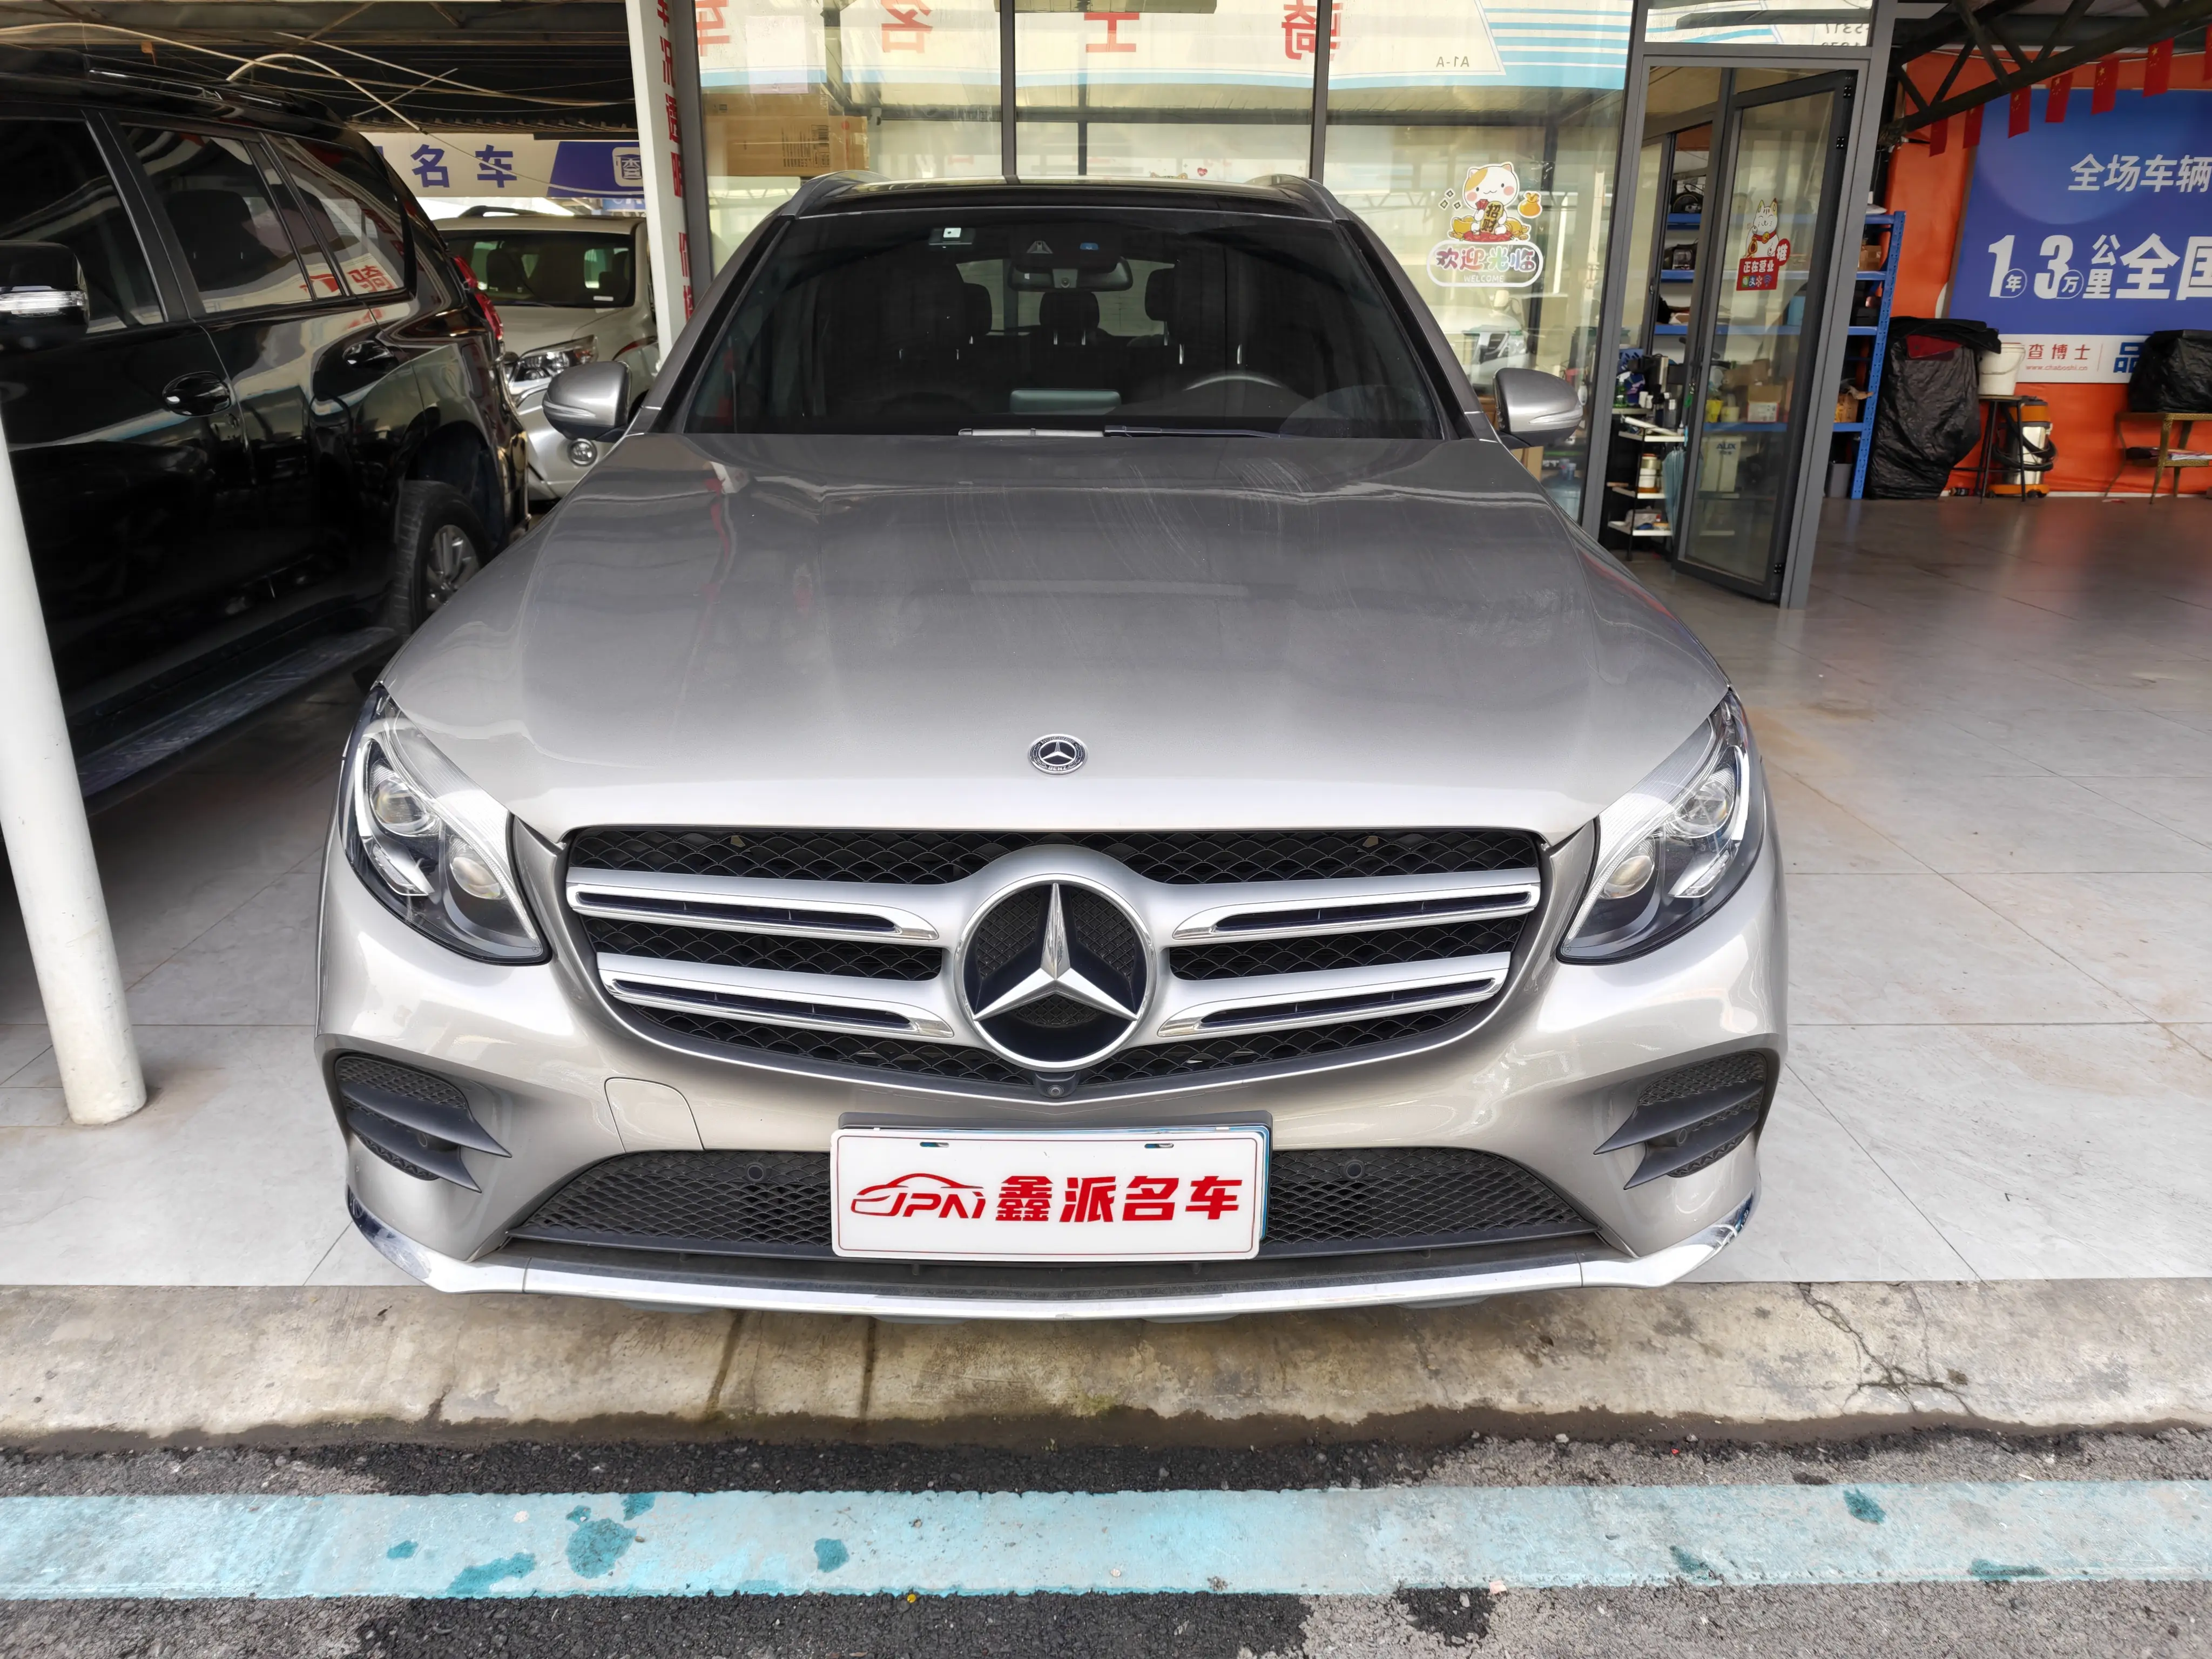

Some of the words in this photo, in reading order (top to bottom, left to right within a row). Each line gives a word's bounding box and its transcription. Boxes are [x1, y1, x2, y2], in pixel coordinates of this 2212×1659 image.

[374, 144, 517, 188] 名车
[2068, 153, 2212, 193] 全场车辆
[1481, 203, 1501, 233] 招财
[1435, 246, 1536, 273] 欢迎光临
[1743, 259, 1775, 273] 正在营业
[1463, 274, 1505, 284] WELCOME
[2027, 343, 2091, 360] 查博士
[995, 1175, 1244, 1224] 鑫派名车
